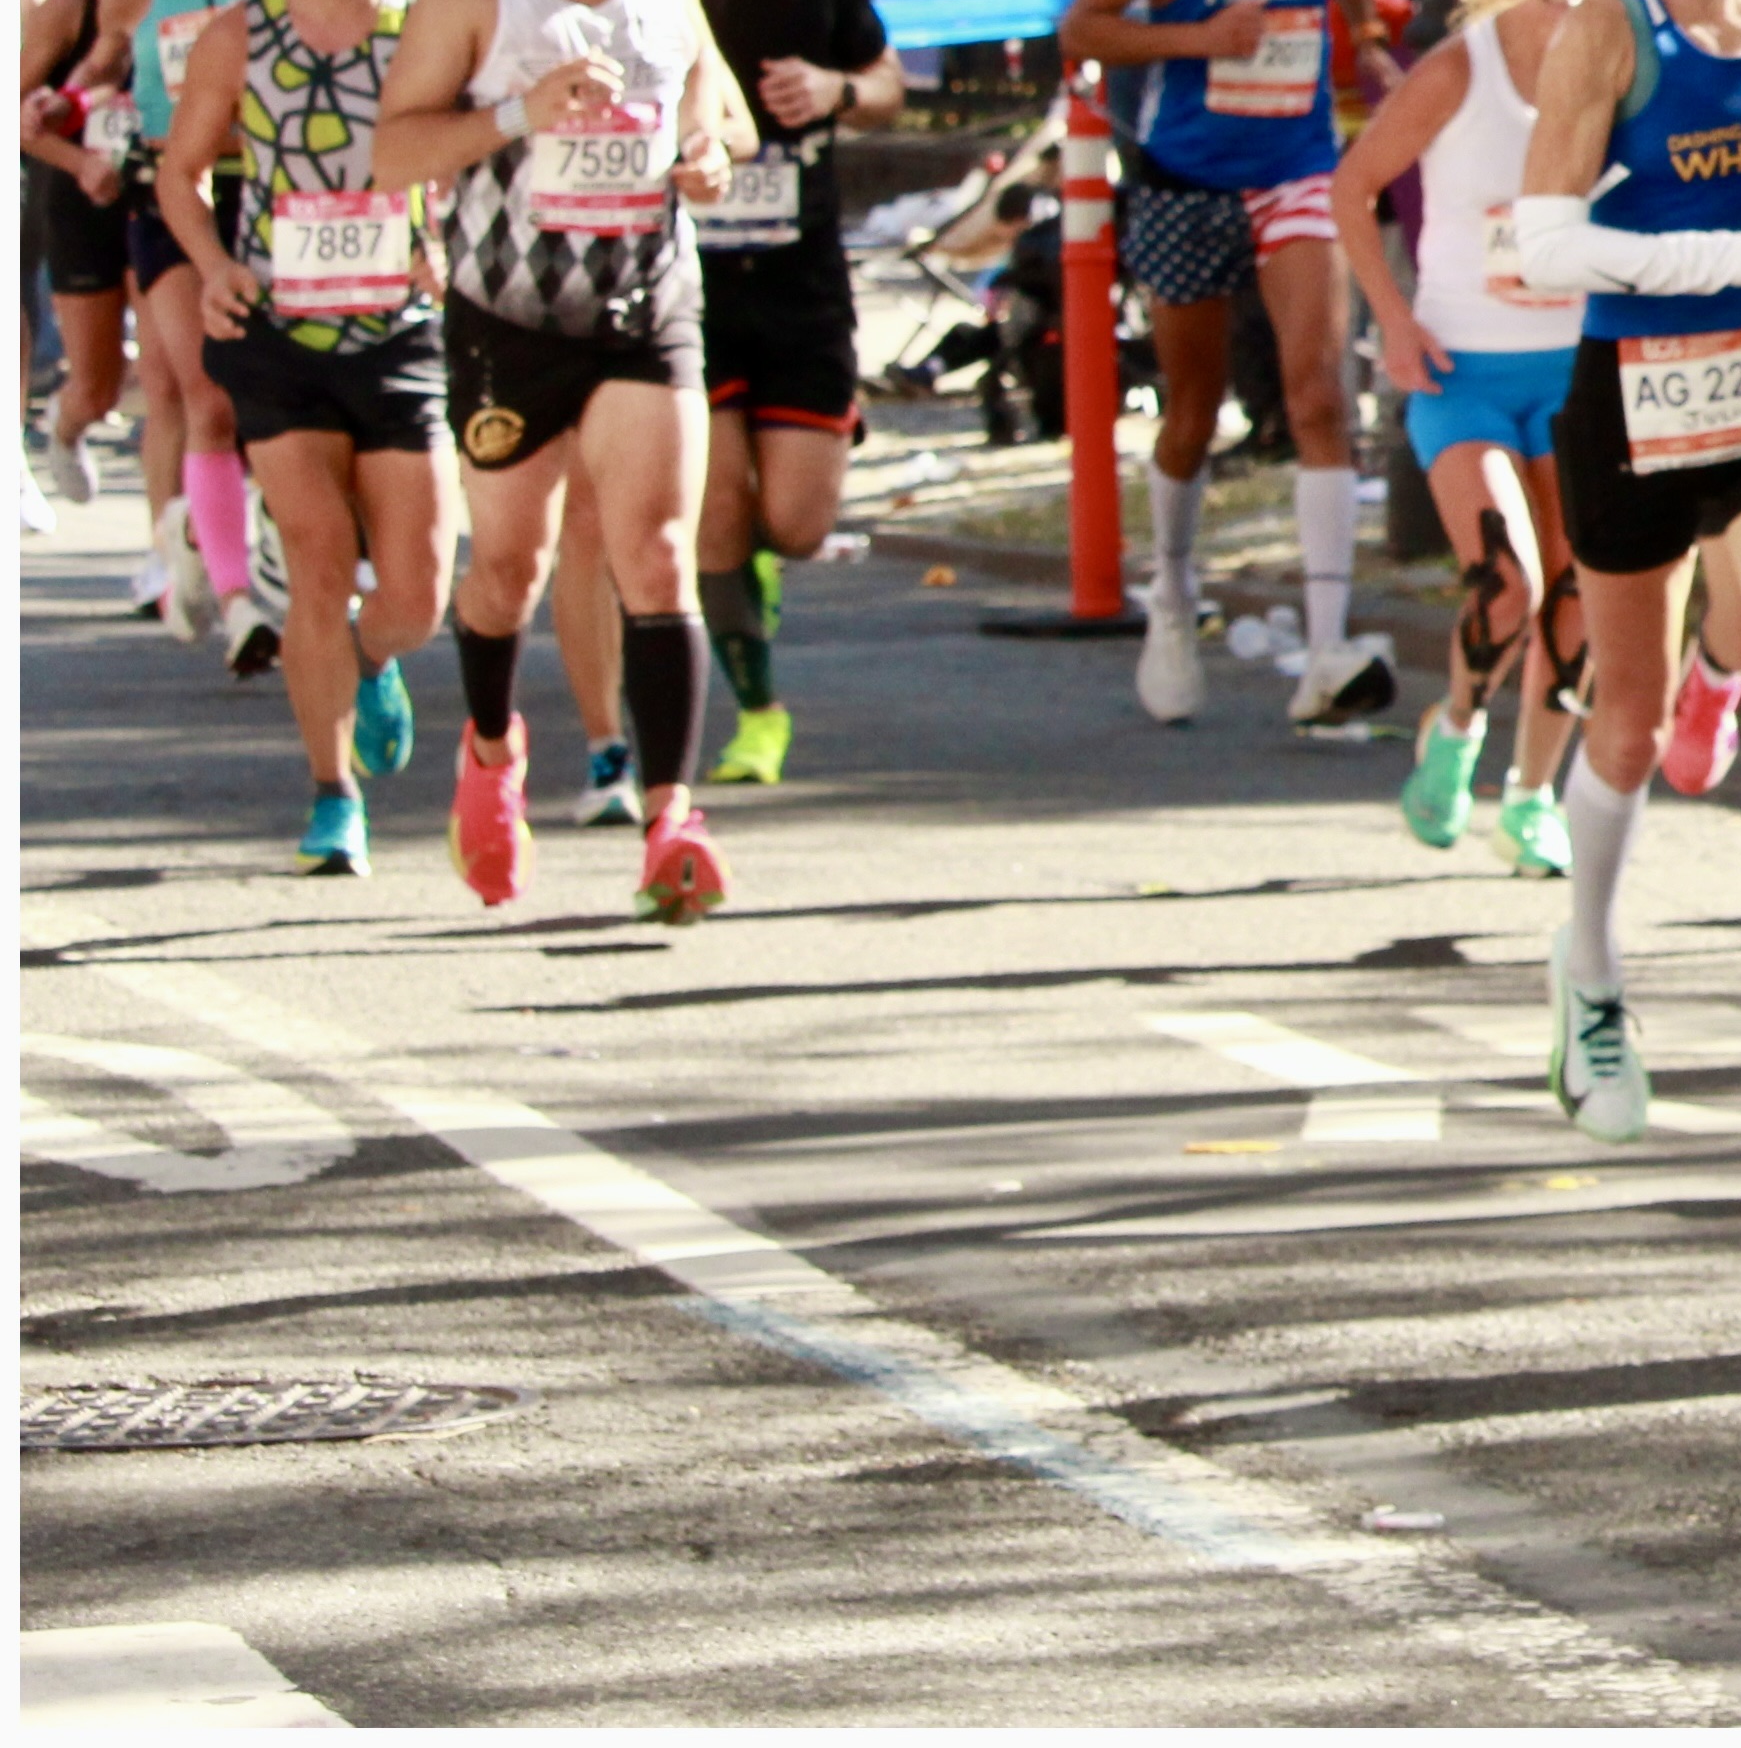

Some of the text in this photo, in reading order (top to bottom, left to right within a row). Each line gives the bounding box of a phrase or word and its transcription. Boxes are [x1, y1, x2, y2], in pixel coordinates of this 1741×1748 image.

[558, 138, 649, 178] 7590
[296, 223, 384, 261] 7887
[1633, 372, 1690, 412] AG
